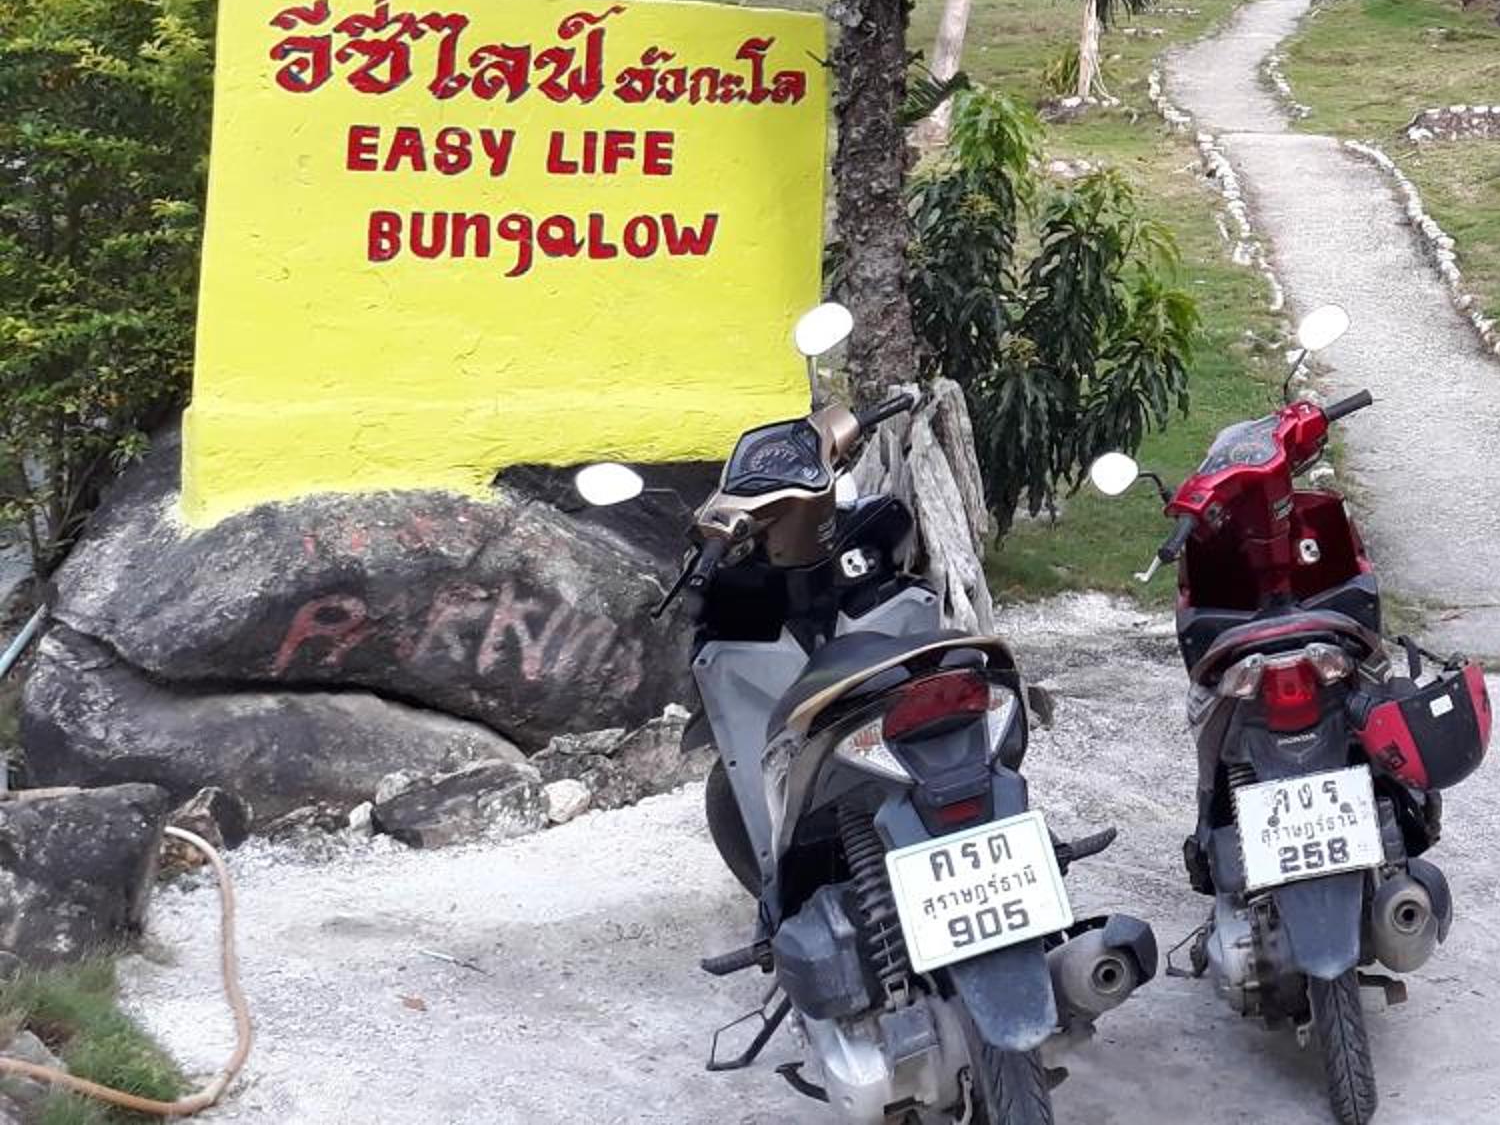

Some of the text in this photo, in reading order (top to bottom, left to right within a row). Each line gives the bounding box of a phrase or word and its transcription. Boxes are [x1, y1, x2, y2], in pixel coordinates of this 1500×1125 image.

[346, 125, 674, 177] EASY LIFE
[1261, 813, 1358, 846] สุราษฎร์ธาน
[1278, 837, 1350, 874] 258
[922, 863, 1037, 919] สุราษฎร์ธานี
[947, 898, 1030, 948] 905
